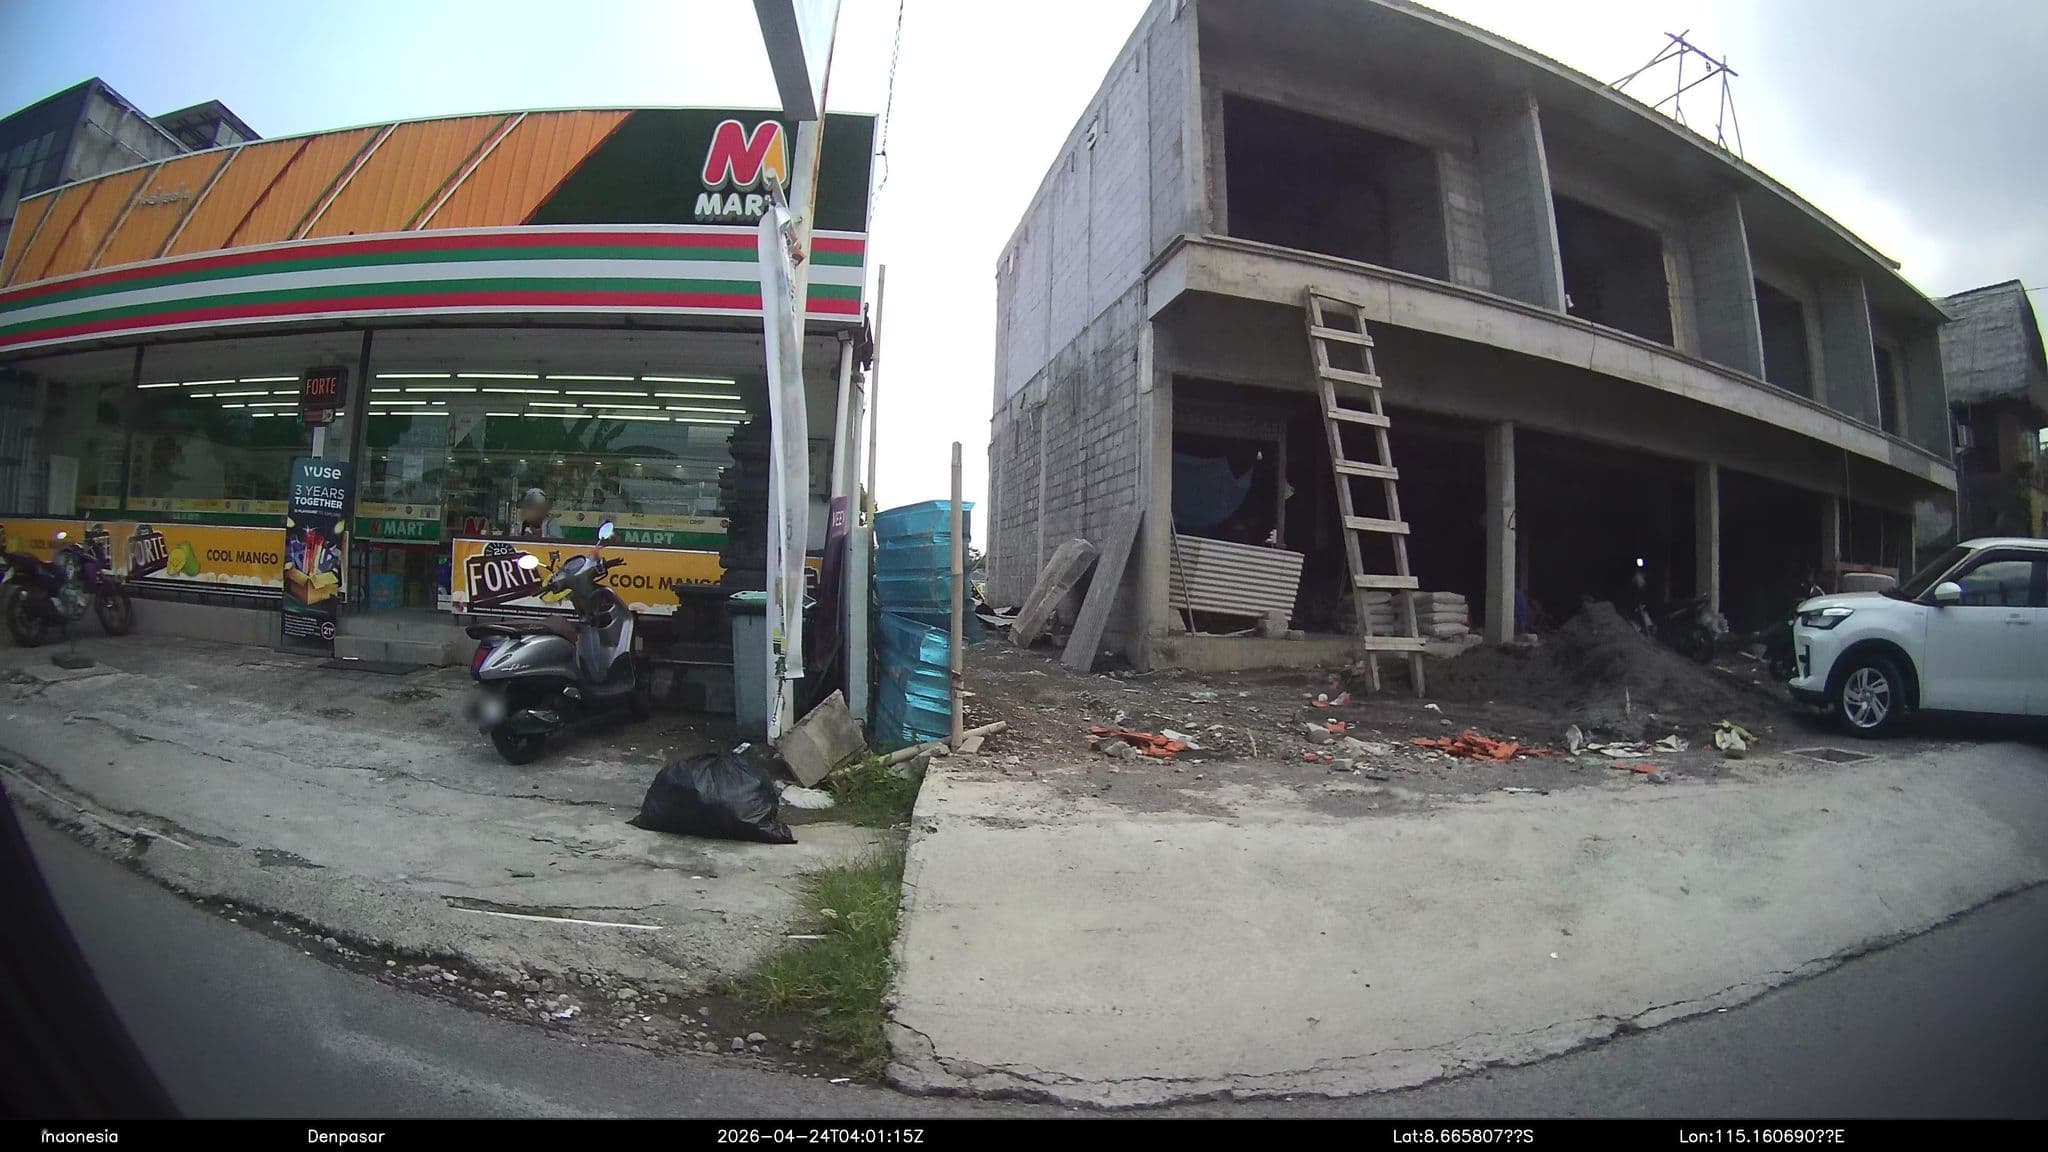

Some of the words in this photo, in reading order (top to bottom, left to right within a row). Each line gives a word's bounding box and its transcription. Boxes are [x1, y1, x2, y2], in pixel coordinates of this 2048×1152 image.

[694, 193, 772, 217] MAR
[305, 377, 337, 395] FORTE
[295, 484, 302, 496] 3
[305, 485, 345, 500] YEARS
[294, 496, 343, 510] TOGETHER
[384, 521, 425, 536] MART
[624, 530, 675, 545] MART
[206, 549, 234, 562] COOL
[236, 551, 279, 565] MANGO
[493, 547, 508, 556] 20
[609, 573, 654, 590] COOL
